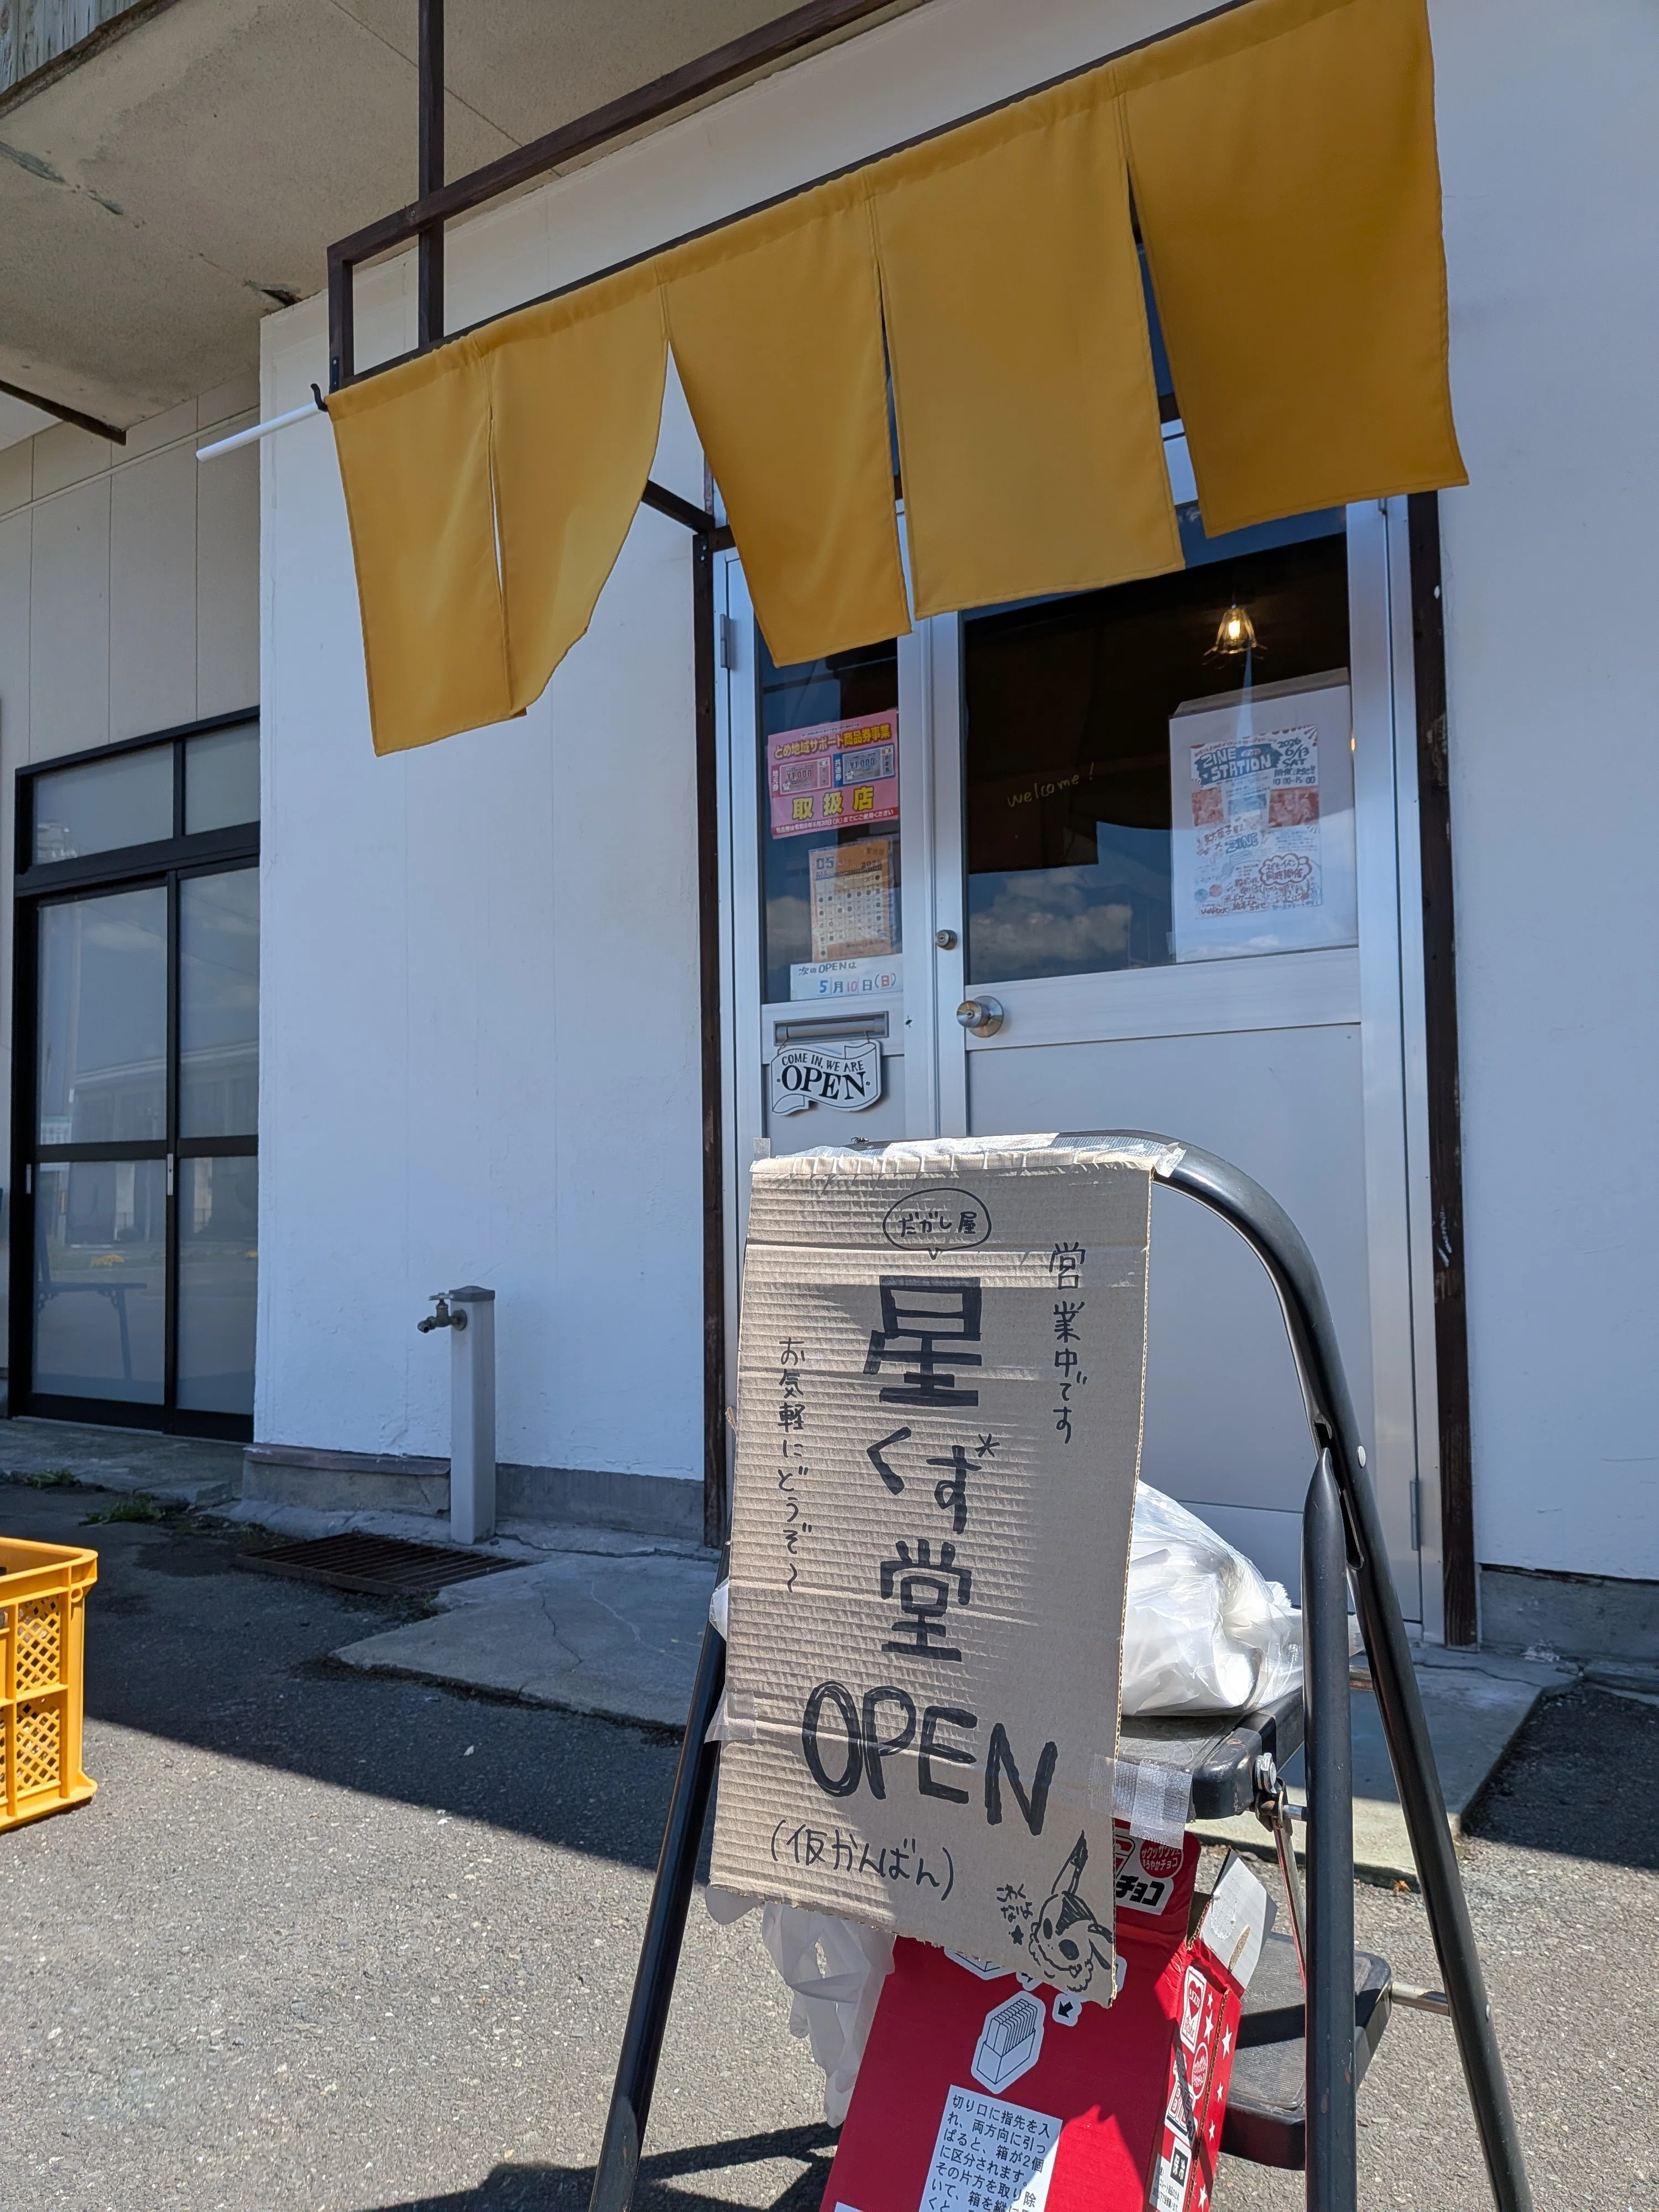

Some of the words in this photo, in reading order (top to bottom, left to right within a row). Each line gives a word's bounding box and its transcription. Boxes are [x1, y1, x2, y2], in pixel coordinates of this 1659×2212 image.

[774, 723, 891, 759] とめ地域サポート商品券事業
[1201, 748, 1236, 768] ZINE
[1211, 754, 1271, 781] STATION
[798, 962, 857, 975] 次のOPENは
[781, 1053, 807, 1066] COME
[811, 1054, 823, 1070] IN,
[826, 1060, 840, 1072] WE
[843, 1060, 864, 1073] ARE
[781, 1065, 867, 1100] OPEN
[898, 1211, 978, 1238] だがし屋
[1048, 1241, 1088, 1445] 営業中です
[801, 1680, 1058, 1836] OPEN
[1116, 1875, 1165, 1906] チョコ
[947, 2111, 1046, 2154] れ、両方向に引っ
[952, 2094, 1050, 2139] 切り口に指先を入
[940, 2145, 1028, 2187] に区分されます。
[943, 2127, 1044, 2173] ぱると、箱が2個
[936, 2161, 1037, 2208] その片方を取り除
